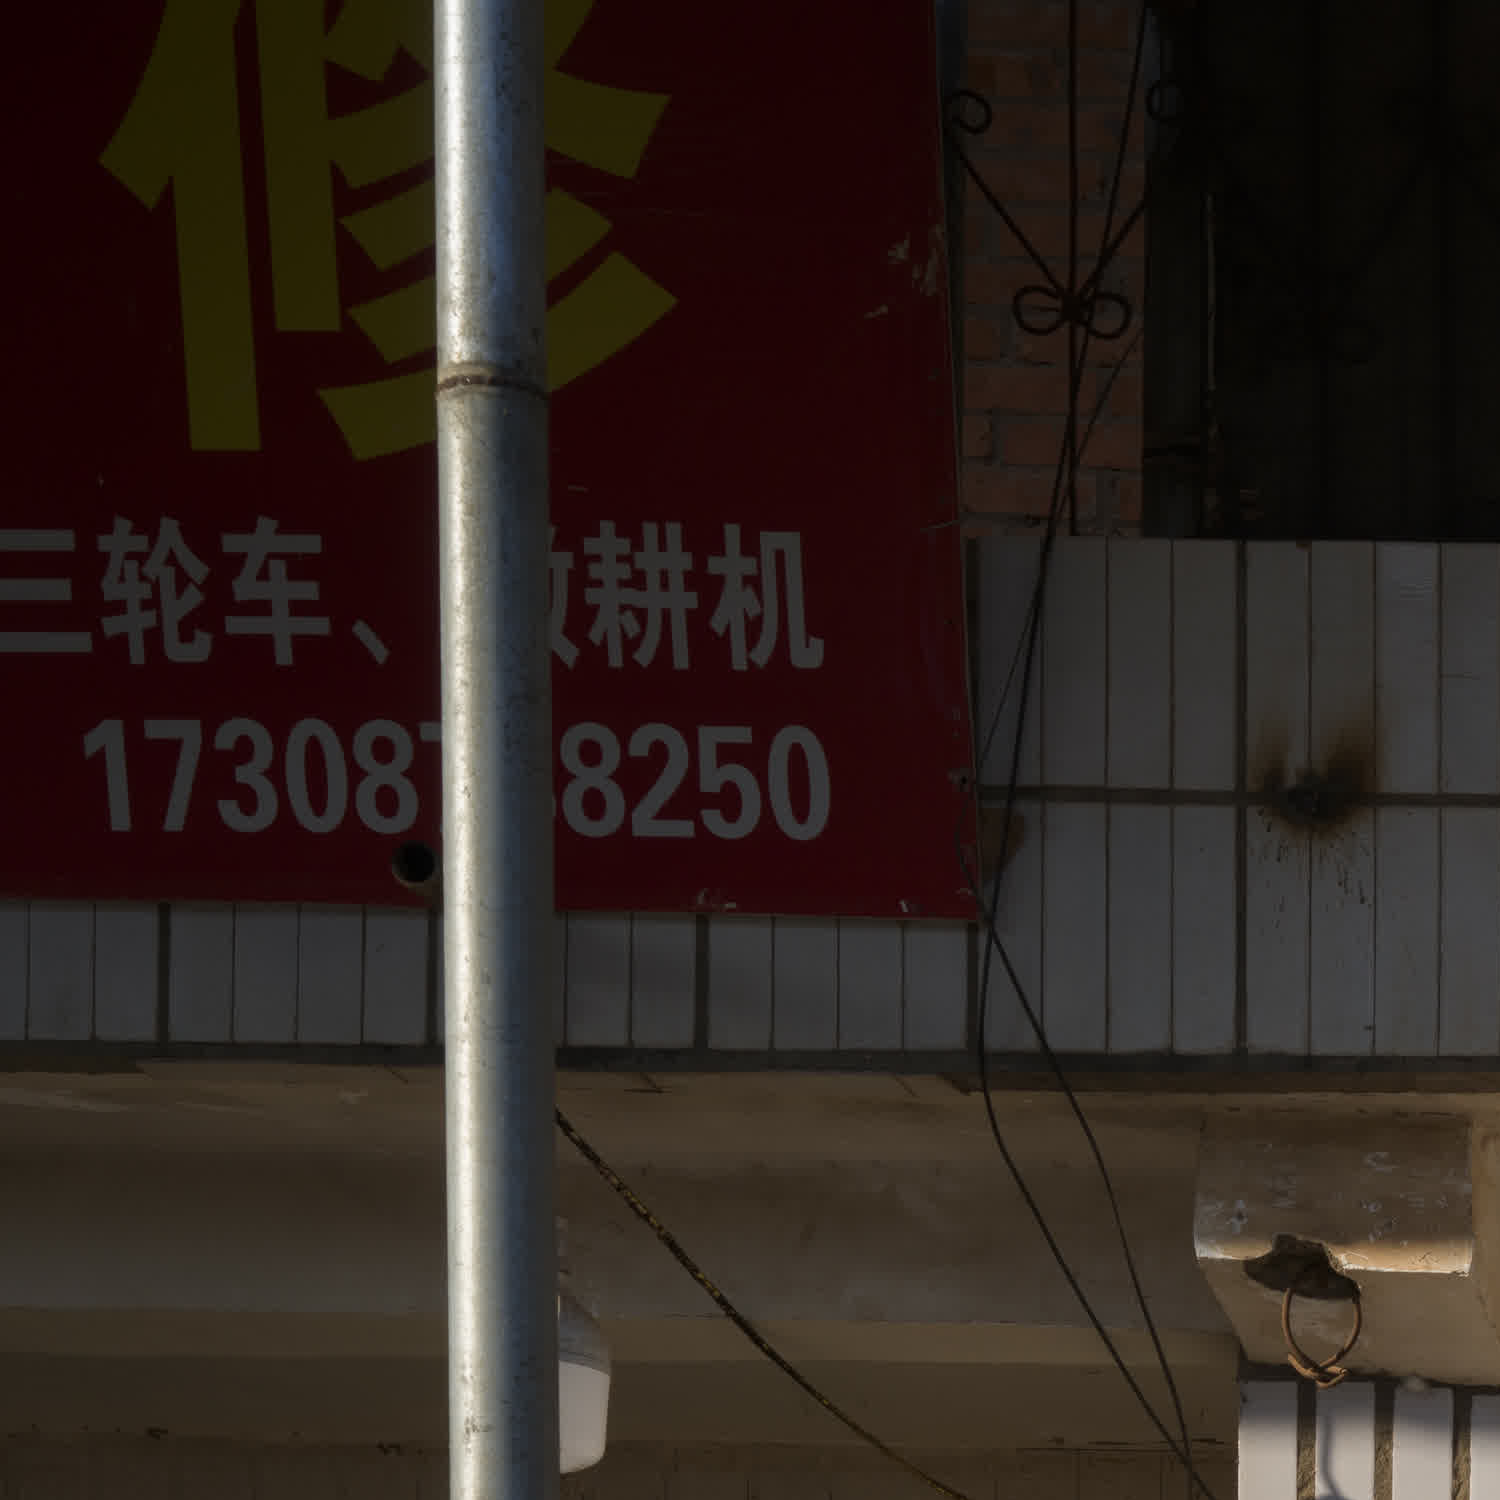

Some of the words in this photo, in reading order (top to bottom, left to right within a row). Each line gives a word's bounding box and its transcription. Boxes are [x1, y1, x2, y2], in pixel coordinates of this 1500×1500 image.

[98, 0, 679, 462] 修
[0, 515, 824, 671] 三轮车、耕机
[83, 717, 832, 842] 173088250
